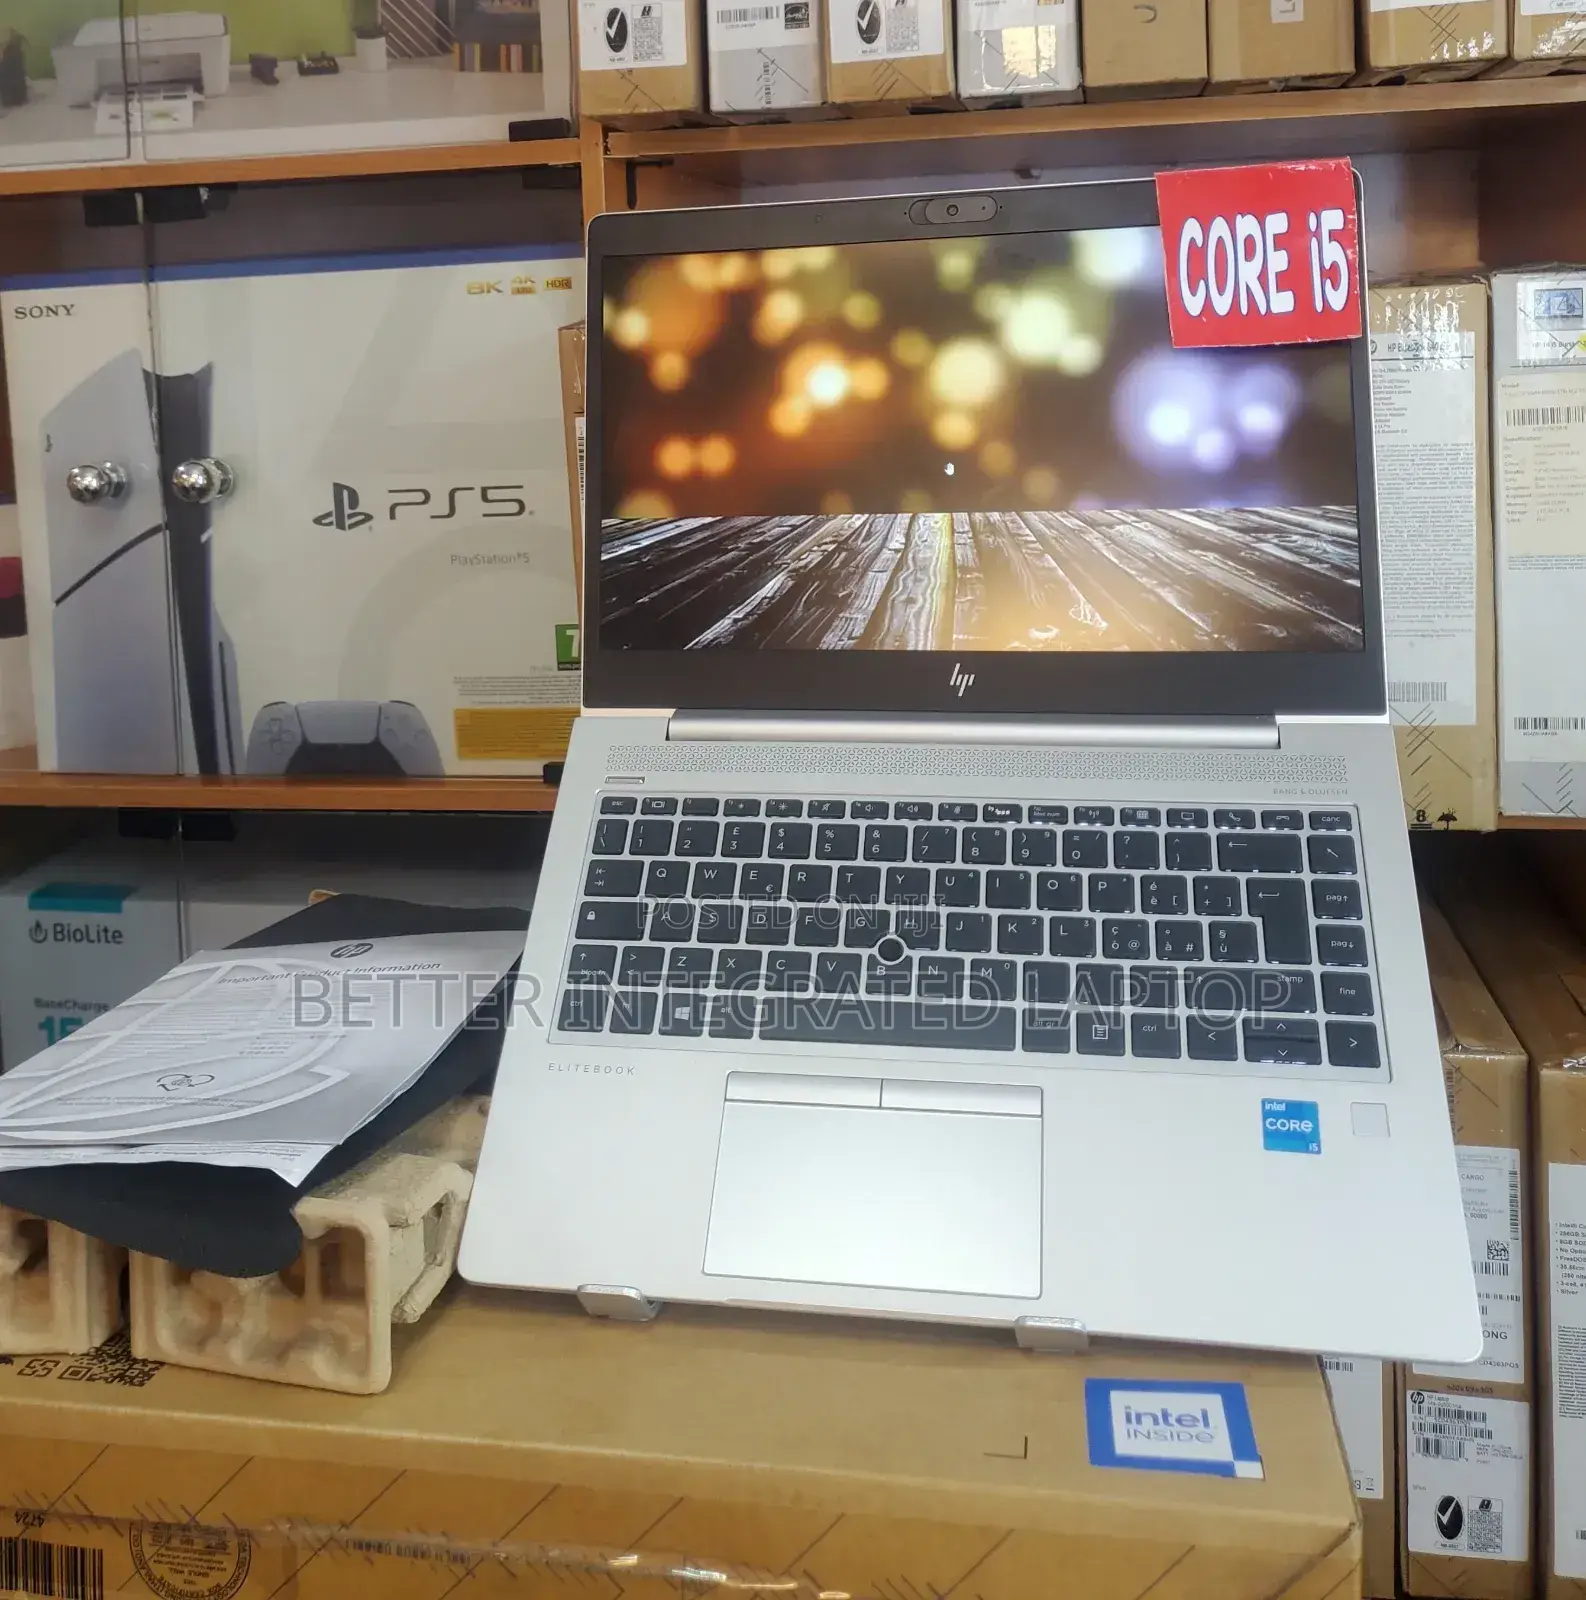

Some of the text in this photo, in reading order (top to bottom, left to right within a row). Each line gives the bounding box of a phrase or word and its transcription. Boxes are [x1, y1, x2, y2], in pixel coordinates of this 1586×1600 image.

[1179, 208, 1349, 318] CORE i5
[546, 278, 569, 288] HDR
[14, 304, 75, 319] SONY
[388, 485, 526, 520] PS5
[950, 663, 975, 697] hp
[1416, 809, 1426, 822] 8
[638, 839, 642, 847] 1
[683, 840, 691, 848] 2
[730, 841, 737, 850] 3
[776, 842, 784, 850] 4
[824, 844, 831, 852] 5
[872, 844, 880, 853] 6
[921, 845, 928, 854] 7
[971, 848, 980, 857] 8
[1021, 849, 1029, 858] 9
[656, 868, 667, 879] Q
[703, 869, 717, 879] W
[750, 870, 758, 880] E
[798, 873, 806, 882] R
[845, 874, 854, 882] T
[896, 875, 904, 884] Y
[945, 876, 955, 886] U
[765, 884, 774, 892] €
[1047, 880, 1058, 890] O
[1098, 881, 1107, 891] P
[1326, 894, 1342, 902] pag
[661, 912, 670, 921] A
[757, 914, 766, 924] D
[805, 916, 813, 925] F
[856, 917, 866, 927] G
[956, 920, 963, 931] J
[53, 922, 123, 944] BioLite
[1008, 923, 1018, 933] K
[1060, 925, 1068, 935] L
[1128, 940, 1140, 950] @
[1186, 943, 1194, 952] #
[1331, 940, 1348, 948] pag
[677, 956, 687, 966] Z
[727, 958, 736, 968] X
[776, 960, 786, 970] C
[827, 961, 837, 972] V
[877, 966, 886, 976] B
[928, 966, 938, 976] N
[218, 971, 294, 985] Important
[354, 962, 442, 974] Information
[982, 967, 993, 978] M
[1278, 975, 1304, 984] stamp
[1339, 987, 1356, 995] fine
[34, 997, 109, 1012] BaseCharge
[548, 1062, 635, 1076] ELITEBOOK
[1264, 1102, 1286, 1111] intel
[1309, 1143, 1319, 1151] i5
[1482, 1330, 1508, 1340] ONG
[1410, 1391, 1425, 1405] hp
[1124, 1405, 1211, 1429] intel
